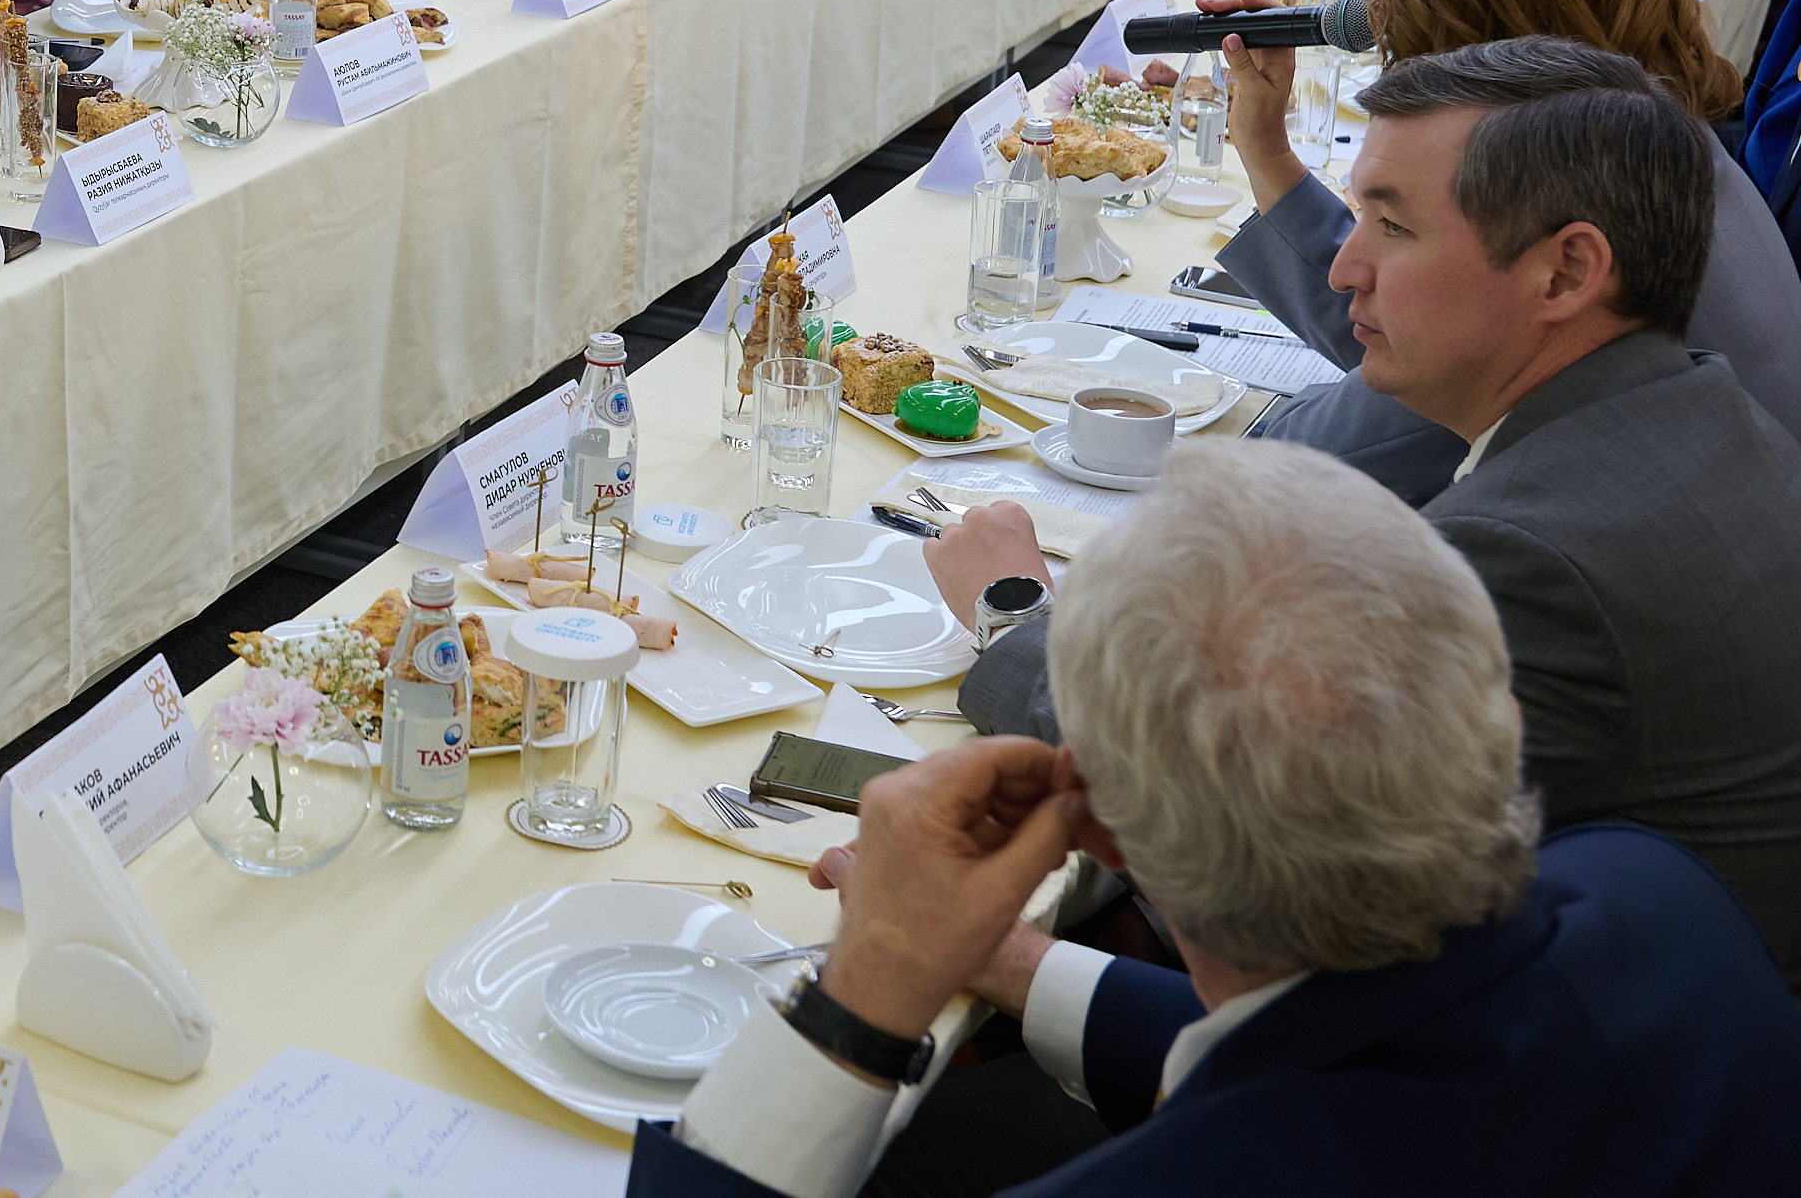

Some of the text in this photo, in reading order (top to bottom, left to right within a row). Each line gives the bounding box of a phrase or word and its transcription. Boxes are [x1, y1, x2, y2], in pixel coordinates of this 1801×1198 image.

[333, 59, 361, 77] АЮЛОВ
[337, 51, 412, 88] РУСТАМ АБИЛЬМАЖИНОВИЧ
[81, 152, 144, 188] ЫДЫРЫСБАЕВА
[87, 159, 163, 201] РАЗИЯ НИЖАТҚЫЗЫ
[479, 452, 529, 489] СМАГУЛОВ
[485, 448, 565, 510] ДИДАР НУРКЕНОВ
[502, 499, 520, 514] Совета
[594, 480, 636, 499] TASSA
[491, 506, 525, 530] независимый
[107, 731, 182, 800] АФАНАСЬЕВИЧ
